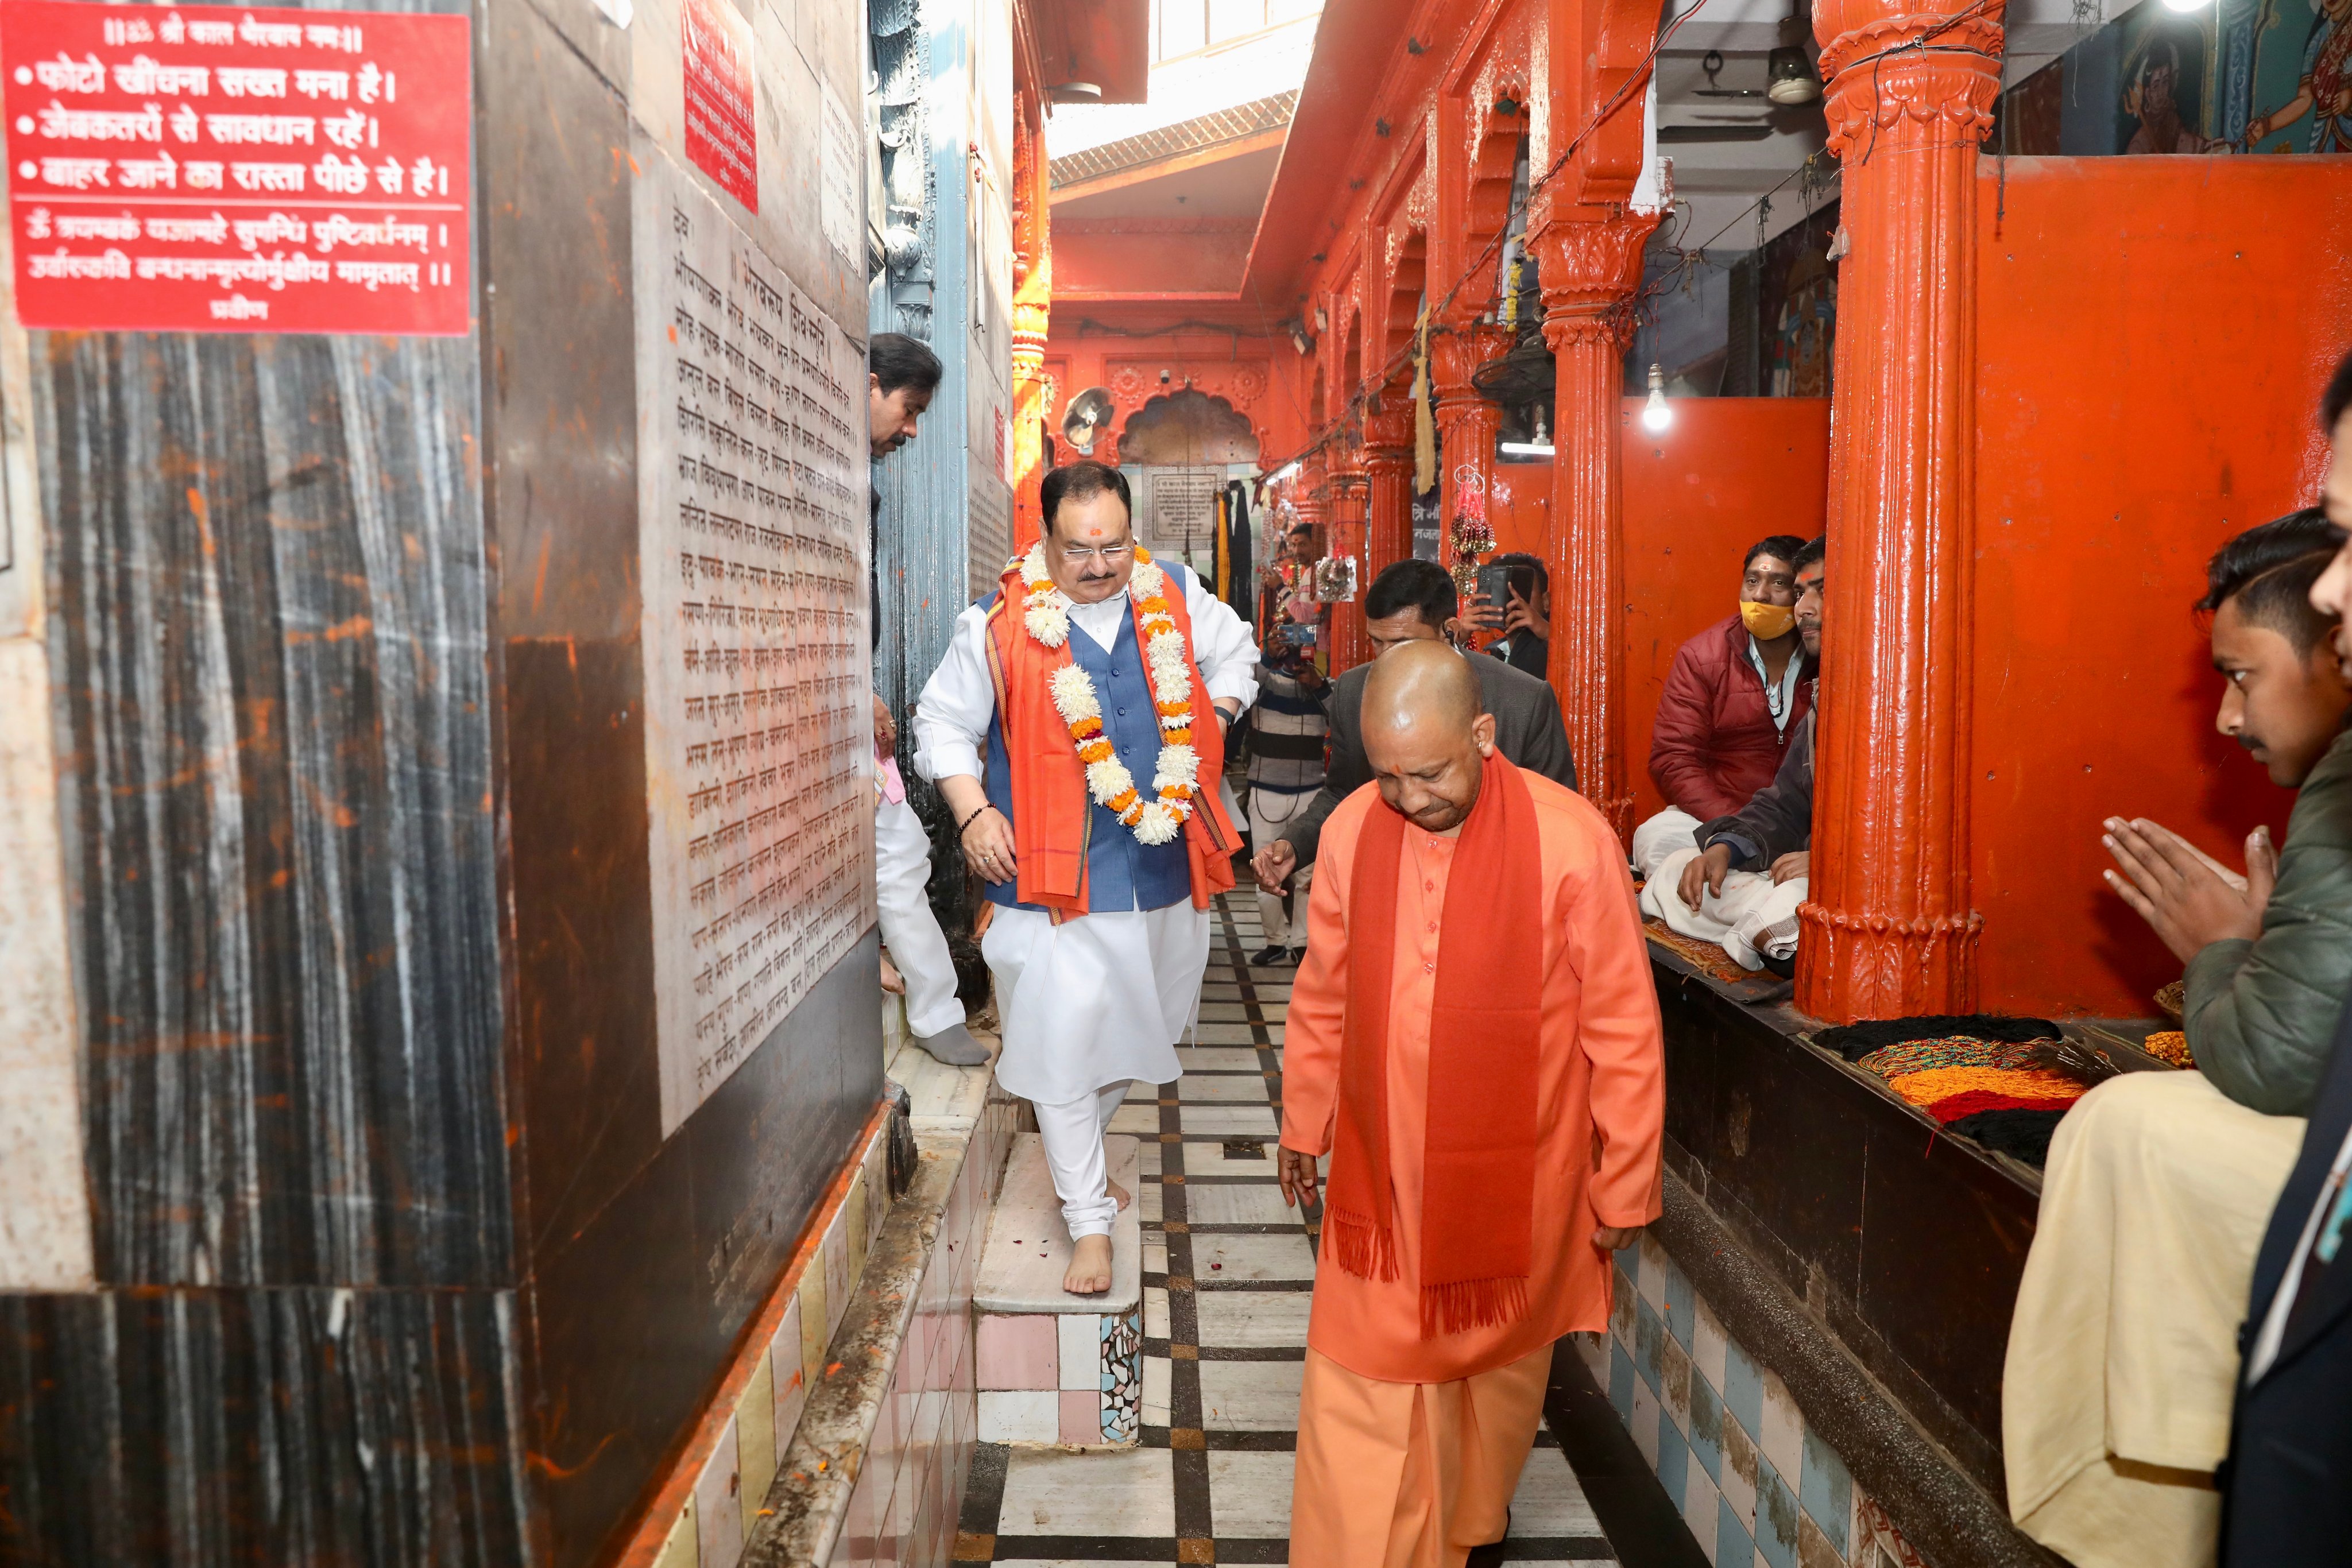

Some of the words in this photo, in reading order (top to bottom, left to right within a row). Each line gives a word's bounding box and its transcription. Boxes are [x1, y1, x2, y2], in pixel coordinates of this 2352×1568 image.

[187, 20, 234, 45] काल
[34, 50, 106, 94] फोटो
[113, 53, 210, 96] खींचना
[215, 65, 287, 98] सख्त
[293, 69, 350, 100] मना
[169, 102, 199, 143] से
[204, 113, 316, 146] सावधान
[40, 156, 111, 190] बाहर
[116, 149, 177, 189] जाने
[183, 161, 224, 190] का
[230, 161, 307, 192] रास्ता
[312, 152, 370, 195] पीछे
[374, 155, 404, 195] से
